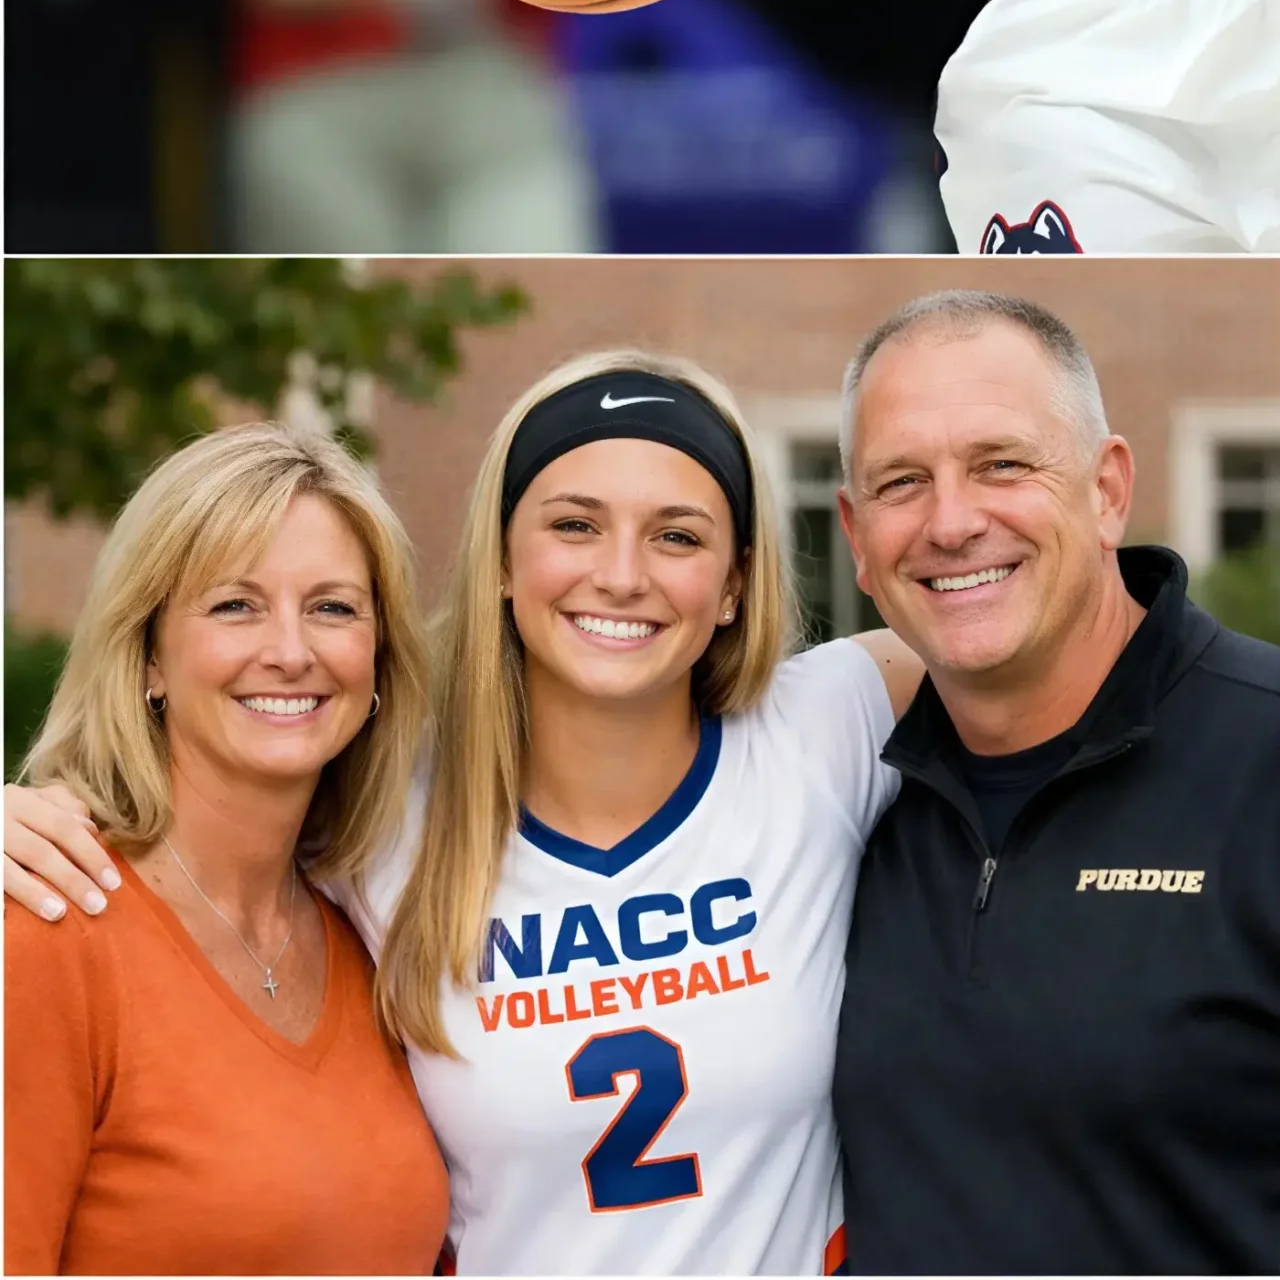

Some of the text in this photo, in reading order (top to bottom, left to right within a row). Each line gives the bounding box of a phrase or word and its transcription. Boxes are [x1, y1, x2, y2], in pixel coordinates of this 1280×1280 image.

[1075, 869, 1205, 893] PURDUE
[477, 877, 758, 983] NACC
[475, 948, 770, 1033] VOLLEYBALL
[564, 1024, 703, 1214] 2
